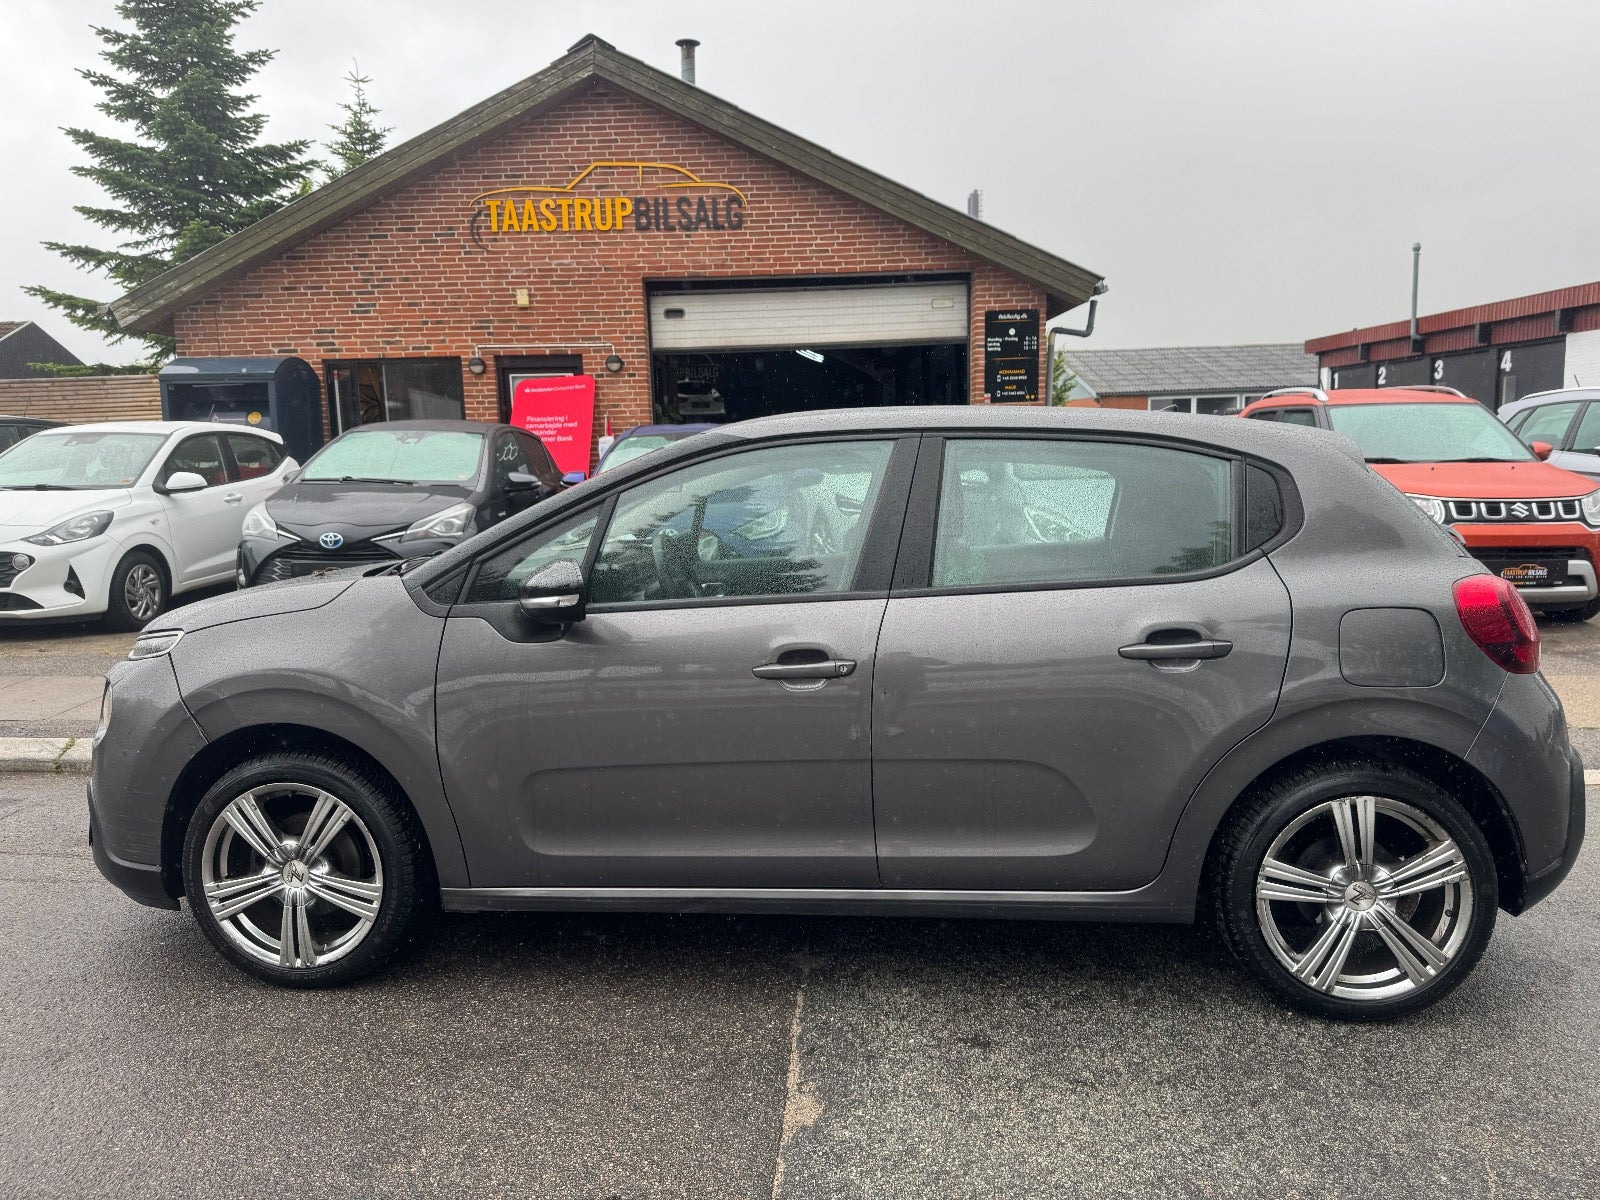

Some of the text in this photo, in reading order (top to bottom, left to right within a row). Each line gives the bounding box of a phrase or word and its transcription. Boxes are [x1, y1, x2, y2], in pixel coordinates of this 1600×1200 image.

[1434, 359, 1444, 380] 3
[1501, 350, 1512, 372] 4
[1333, 372, 1339, 389] 1
[1377, 366, 1386, 385] 2
[526, 422, 563, 430] samarbejde
